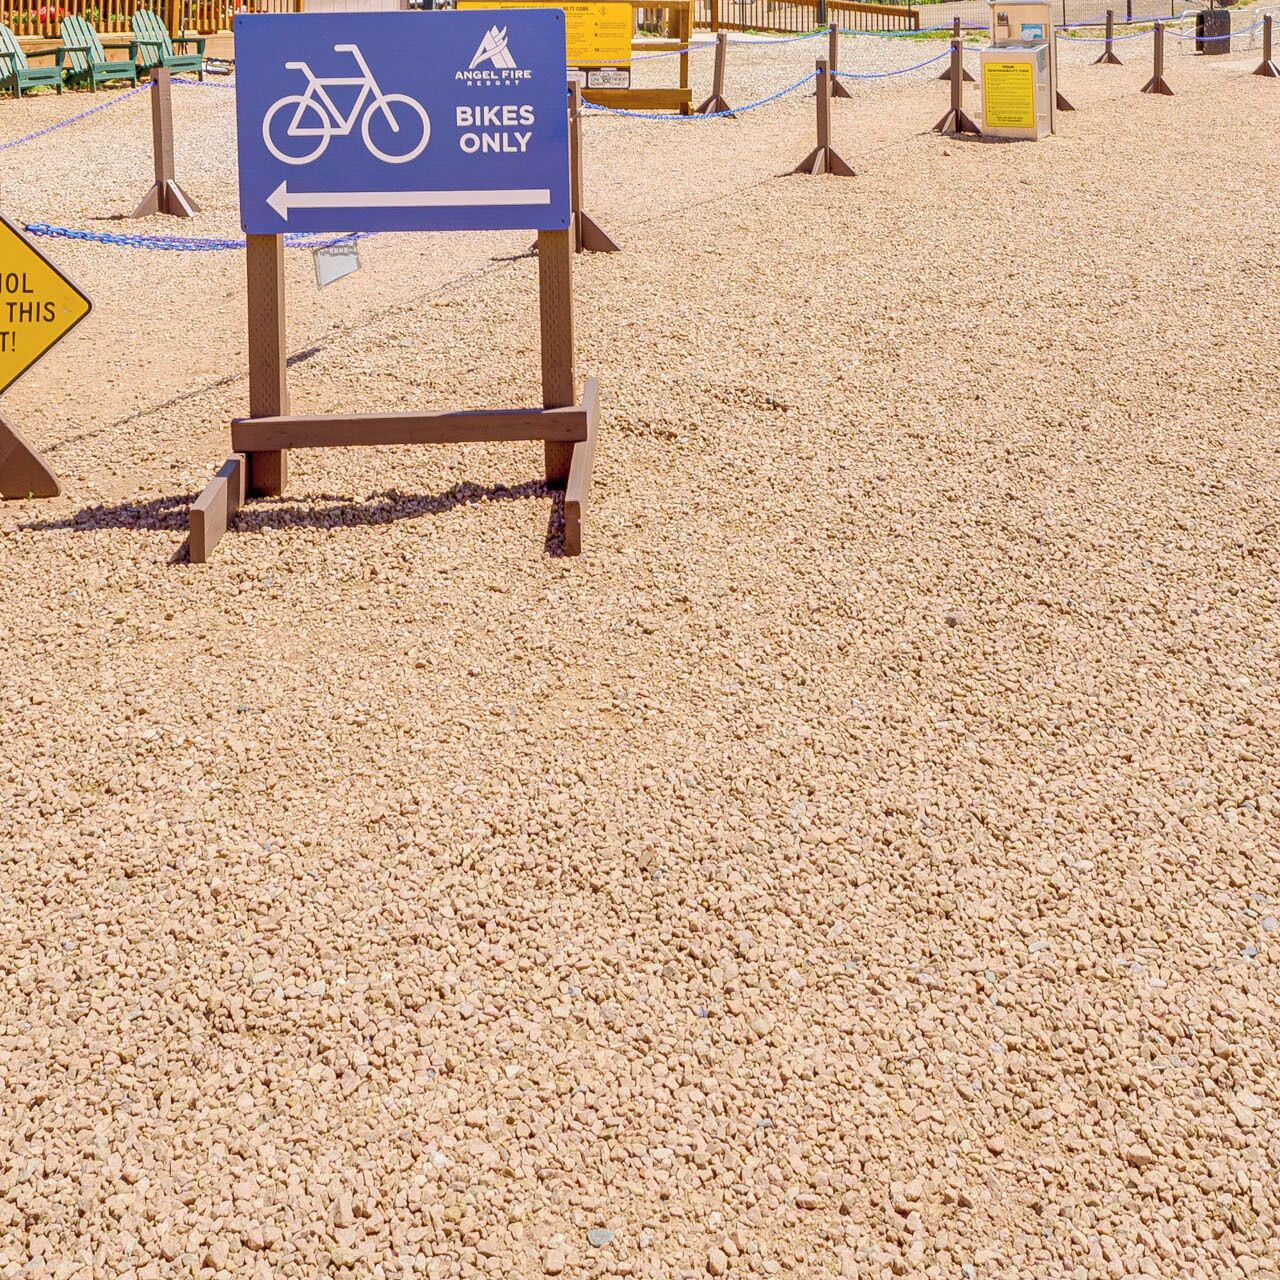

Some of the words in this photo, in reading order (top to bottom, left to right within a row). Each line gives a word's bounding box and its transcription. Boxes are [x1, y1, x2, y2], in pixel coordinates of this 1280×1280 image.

[455, 70, 499, 80] ANGEL
[502, 69, 531, 79] FIRE
[456, 105, 535, 127] BIKES
[459, 132, 533, 153] ONLY
[6, 301, 56, 322] THIS
